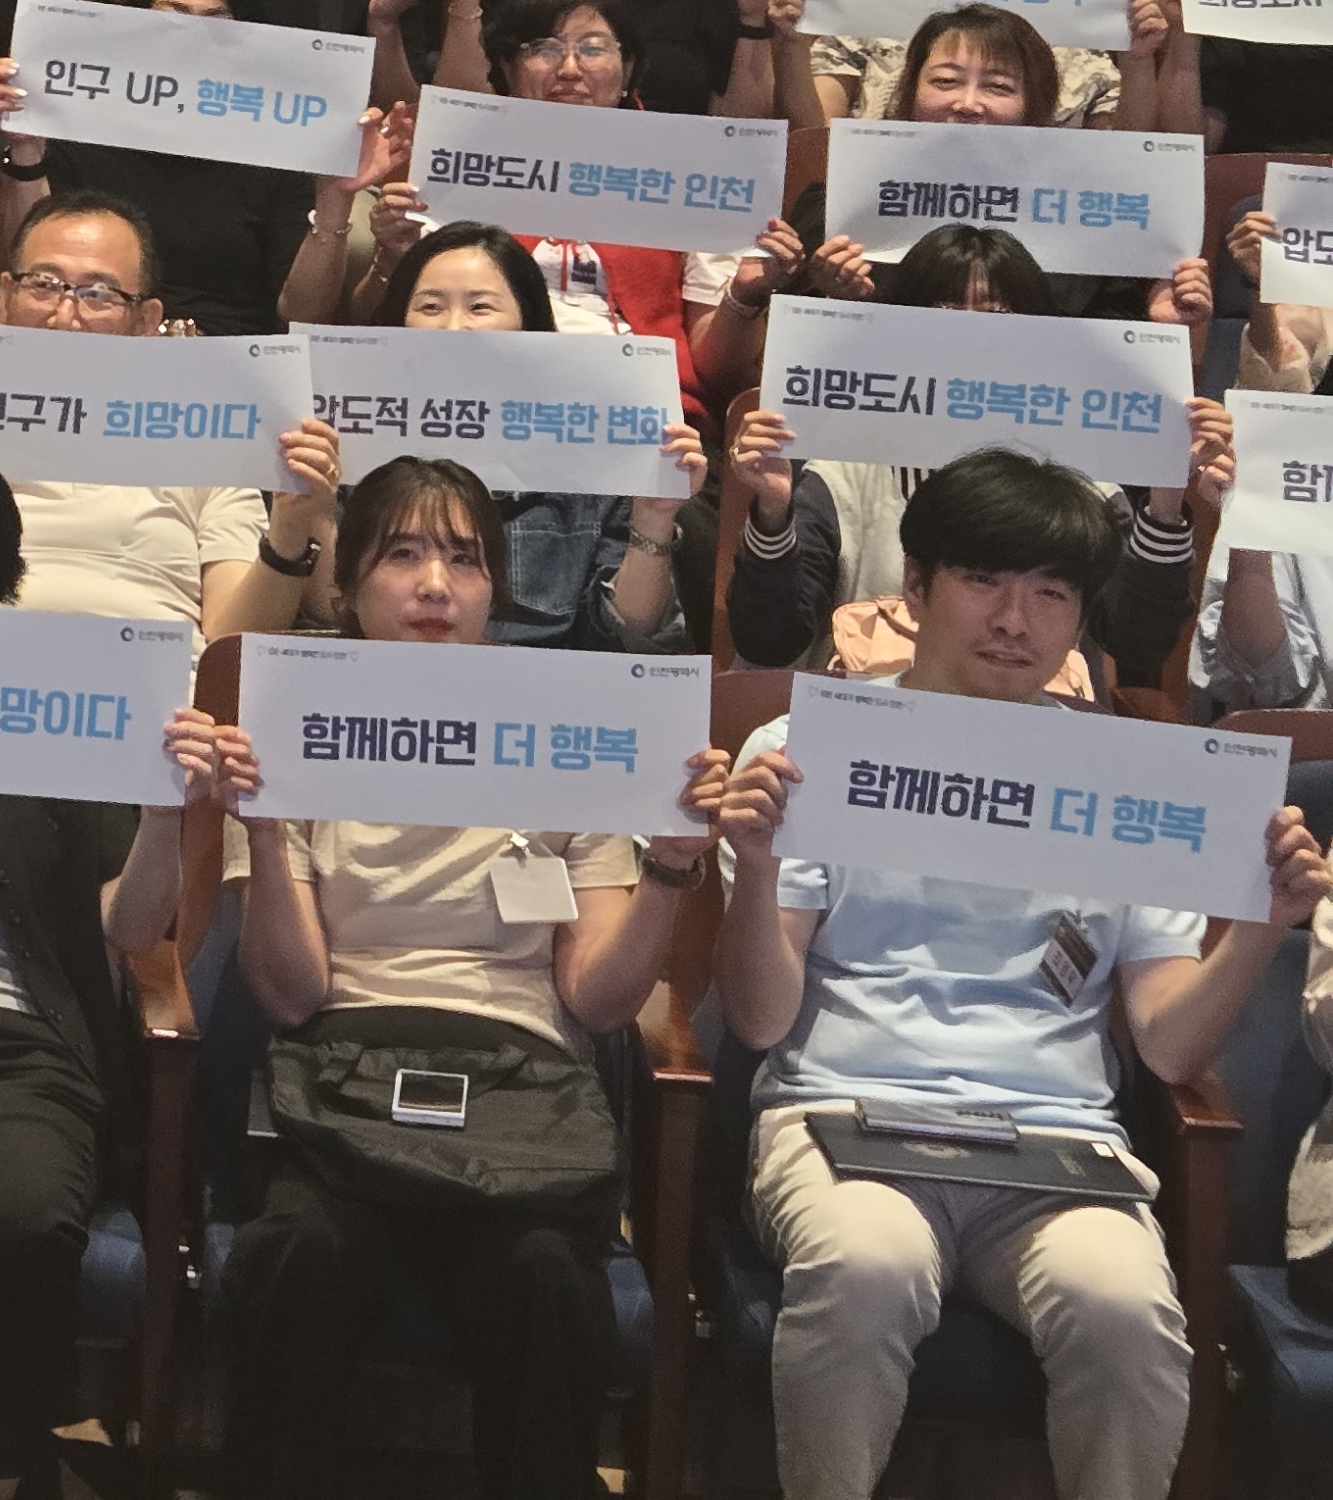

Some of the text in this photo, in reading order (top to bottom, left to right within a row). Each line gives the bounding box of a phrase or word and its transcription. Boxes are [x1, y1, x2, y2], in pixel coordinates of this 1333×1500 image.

[44, 59, 327, 126] 인구 UP, 행복 UP
[426, 147, 754, 212] 희망도시 행복한 인천
[878, 179, 1149, 230] 함께하면 더 행복
[103, 400, 261, 439] 희망이다
[781, 364, 1161, 433] 희망도시 행복한 인천
[302, 712, 638, 773] 함께하면 더 행복
[847, 759, 1205, 852] 함께하면 더 행복
